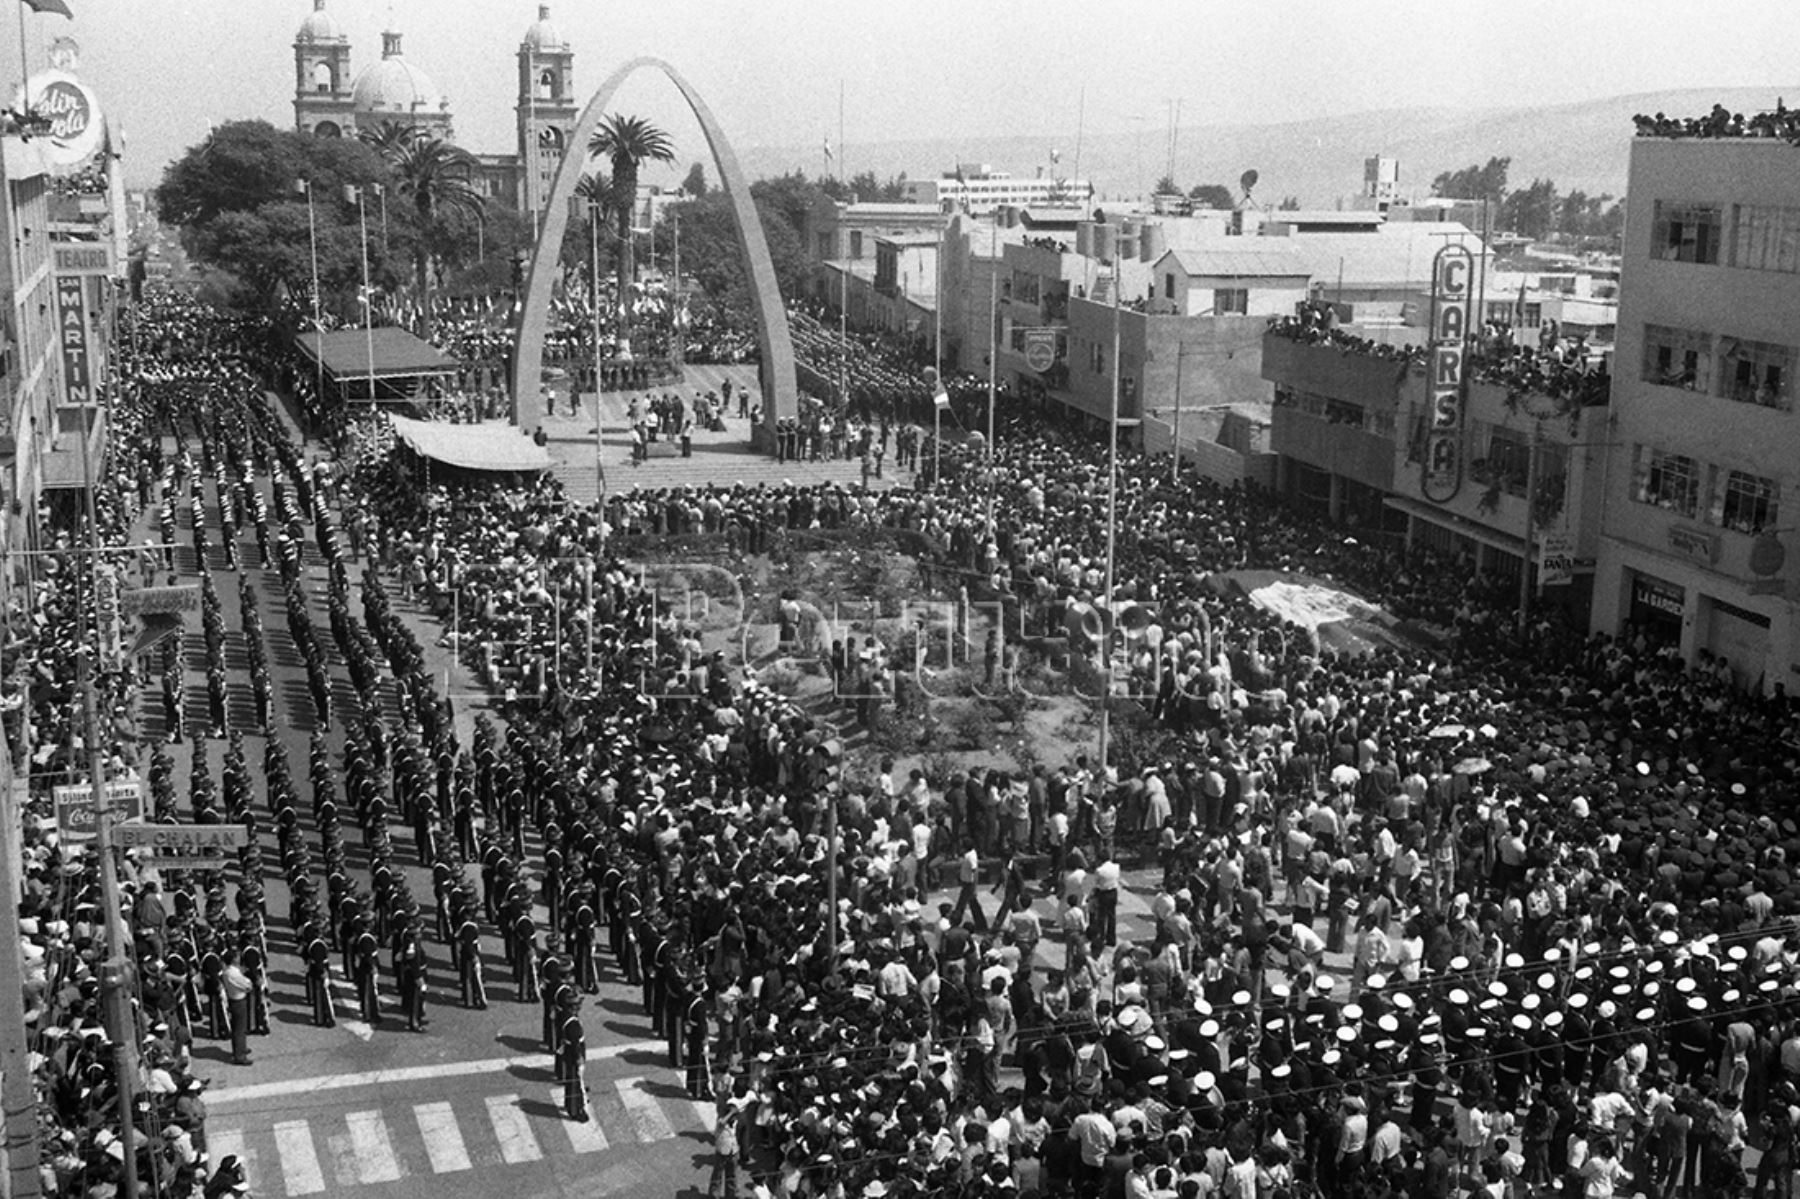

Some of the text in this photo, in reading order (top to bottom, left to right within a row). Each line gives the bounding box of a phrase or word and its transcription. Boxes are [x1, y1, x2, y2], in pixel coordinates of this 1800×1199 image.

[55, 250, 108, 268] TEATRO
[59, 278, 80, 288] SAN
[61, 291, 88, 401] MARTIN
[1434, 259, 1466, 472] CARSA
[122, 831, 236, 847] EL CHALAN
